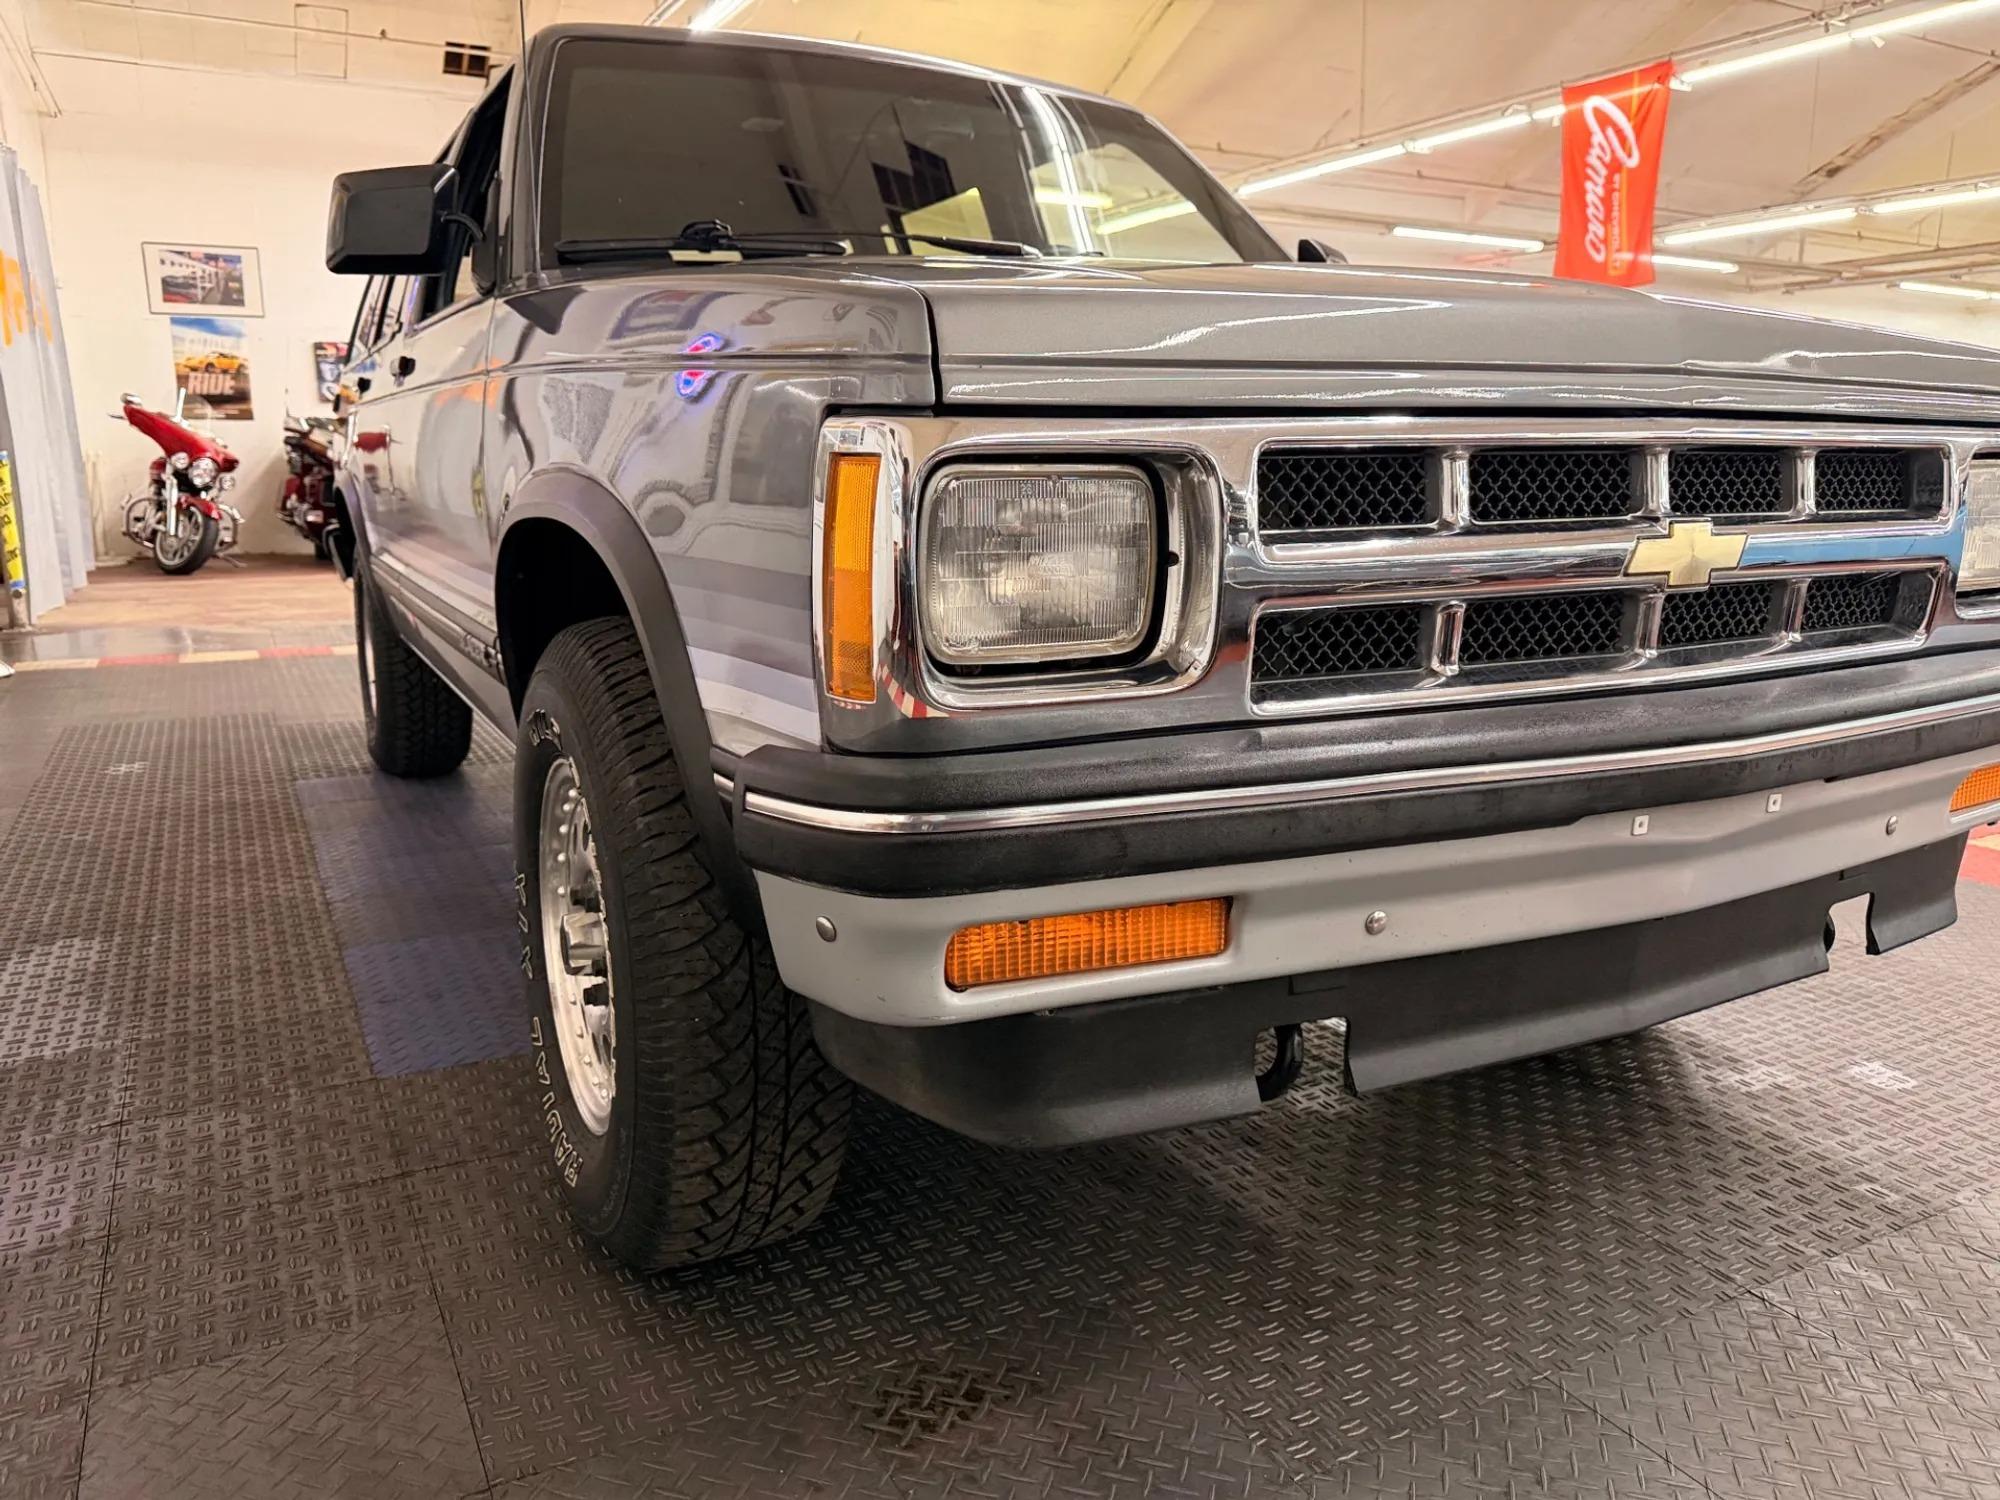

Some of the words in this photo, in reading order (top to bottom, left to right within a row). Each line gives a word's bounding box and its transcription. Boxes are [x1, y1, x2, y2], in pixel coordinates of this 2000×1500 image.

[1584, 96, 1640, 264] Camaro
[188, 371, 236, 396] RIDE
[531, 1016, 583, 1187] RADIAL
